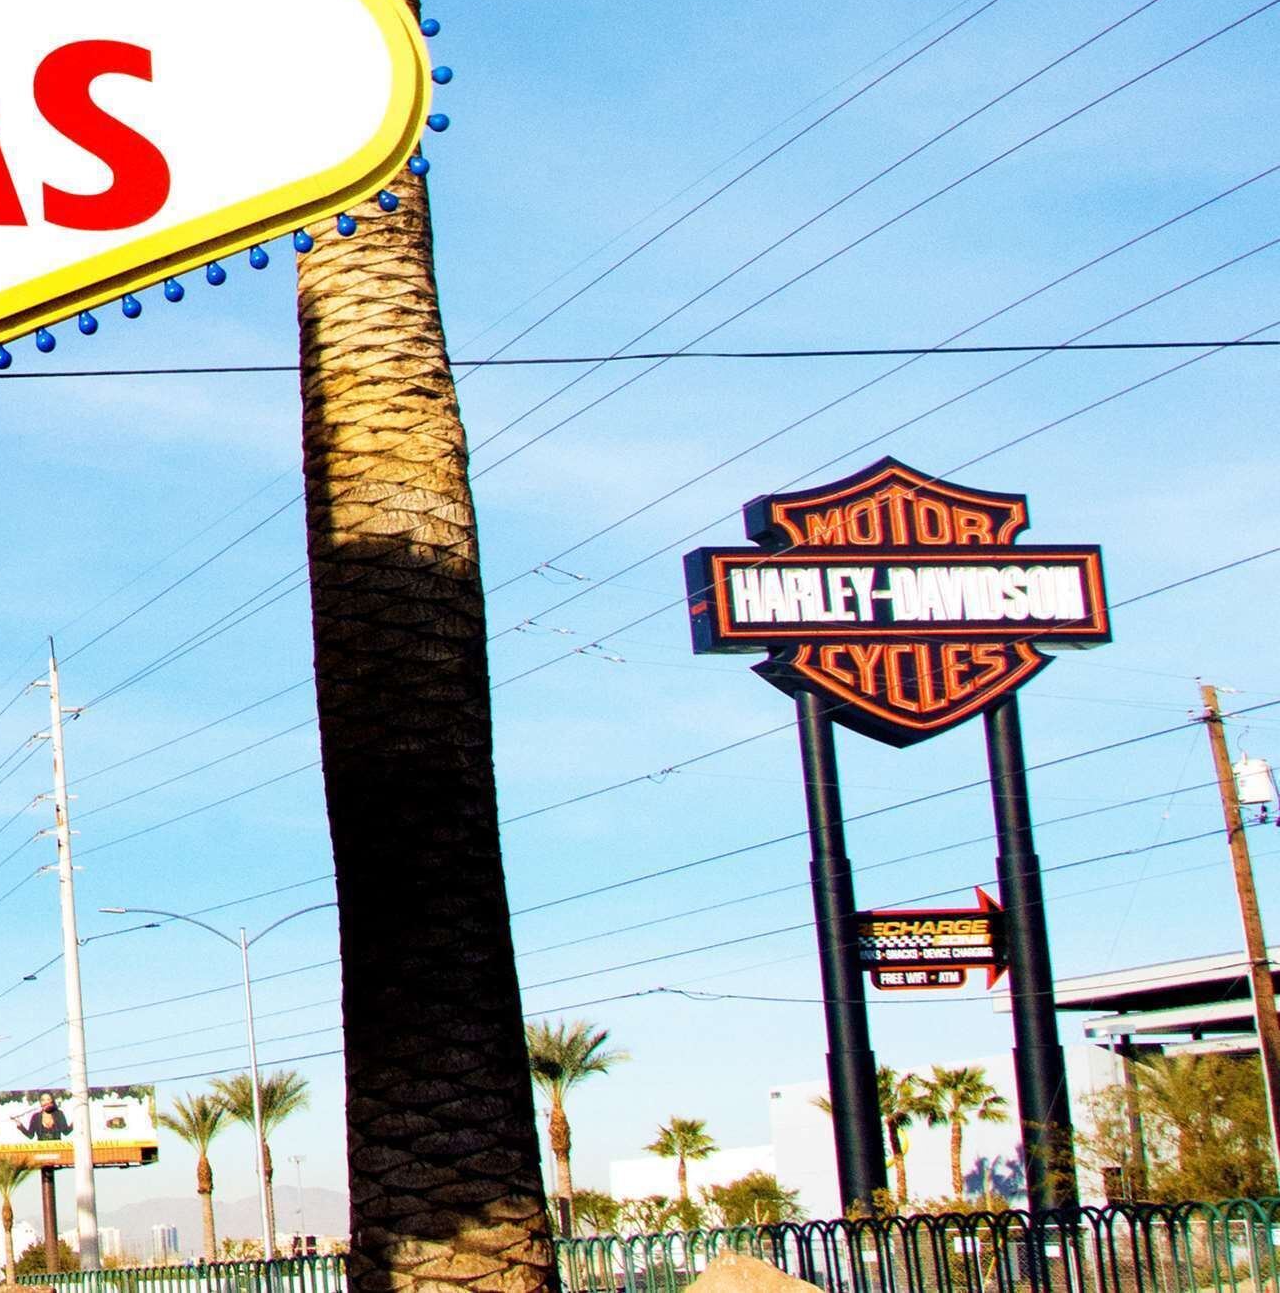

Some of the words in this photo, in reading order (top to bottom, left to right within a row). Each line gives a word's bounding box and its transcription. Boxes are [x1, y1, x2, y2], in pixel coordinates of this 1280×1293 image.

[805, 481, 992, 546] MOTOR
[729, 564, 1088, 624] HARLEY-DAVIDSON
[819, 641, 1011, 714] CYCLES
[879, 971, 905, 985] FREE
[938, 971, 960, 983] ATM
